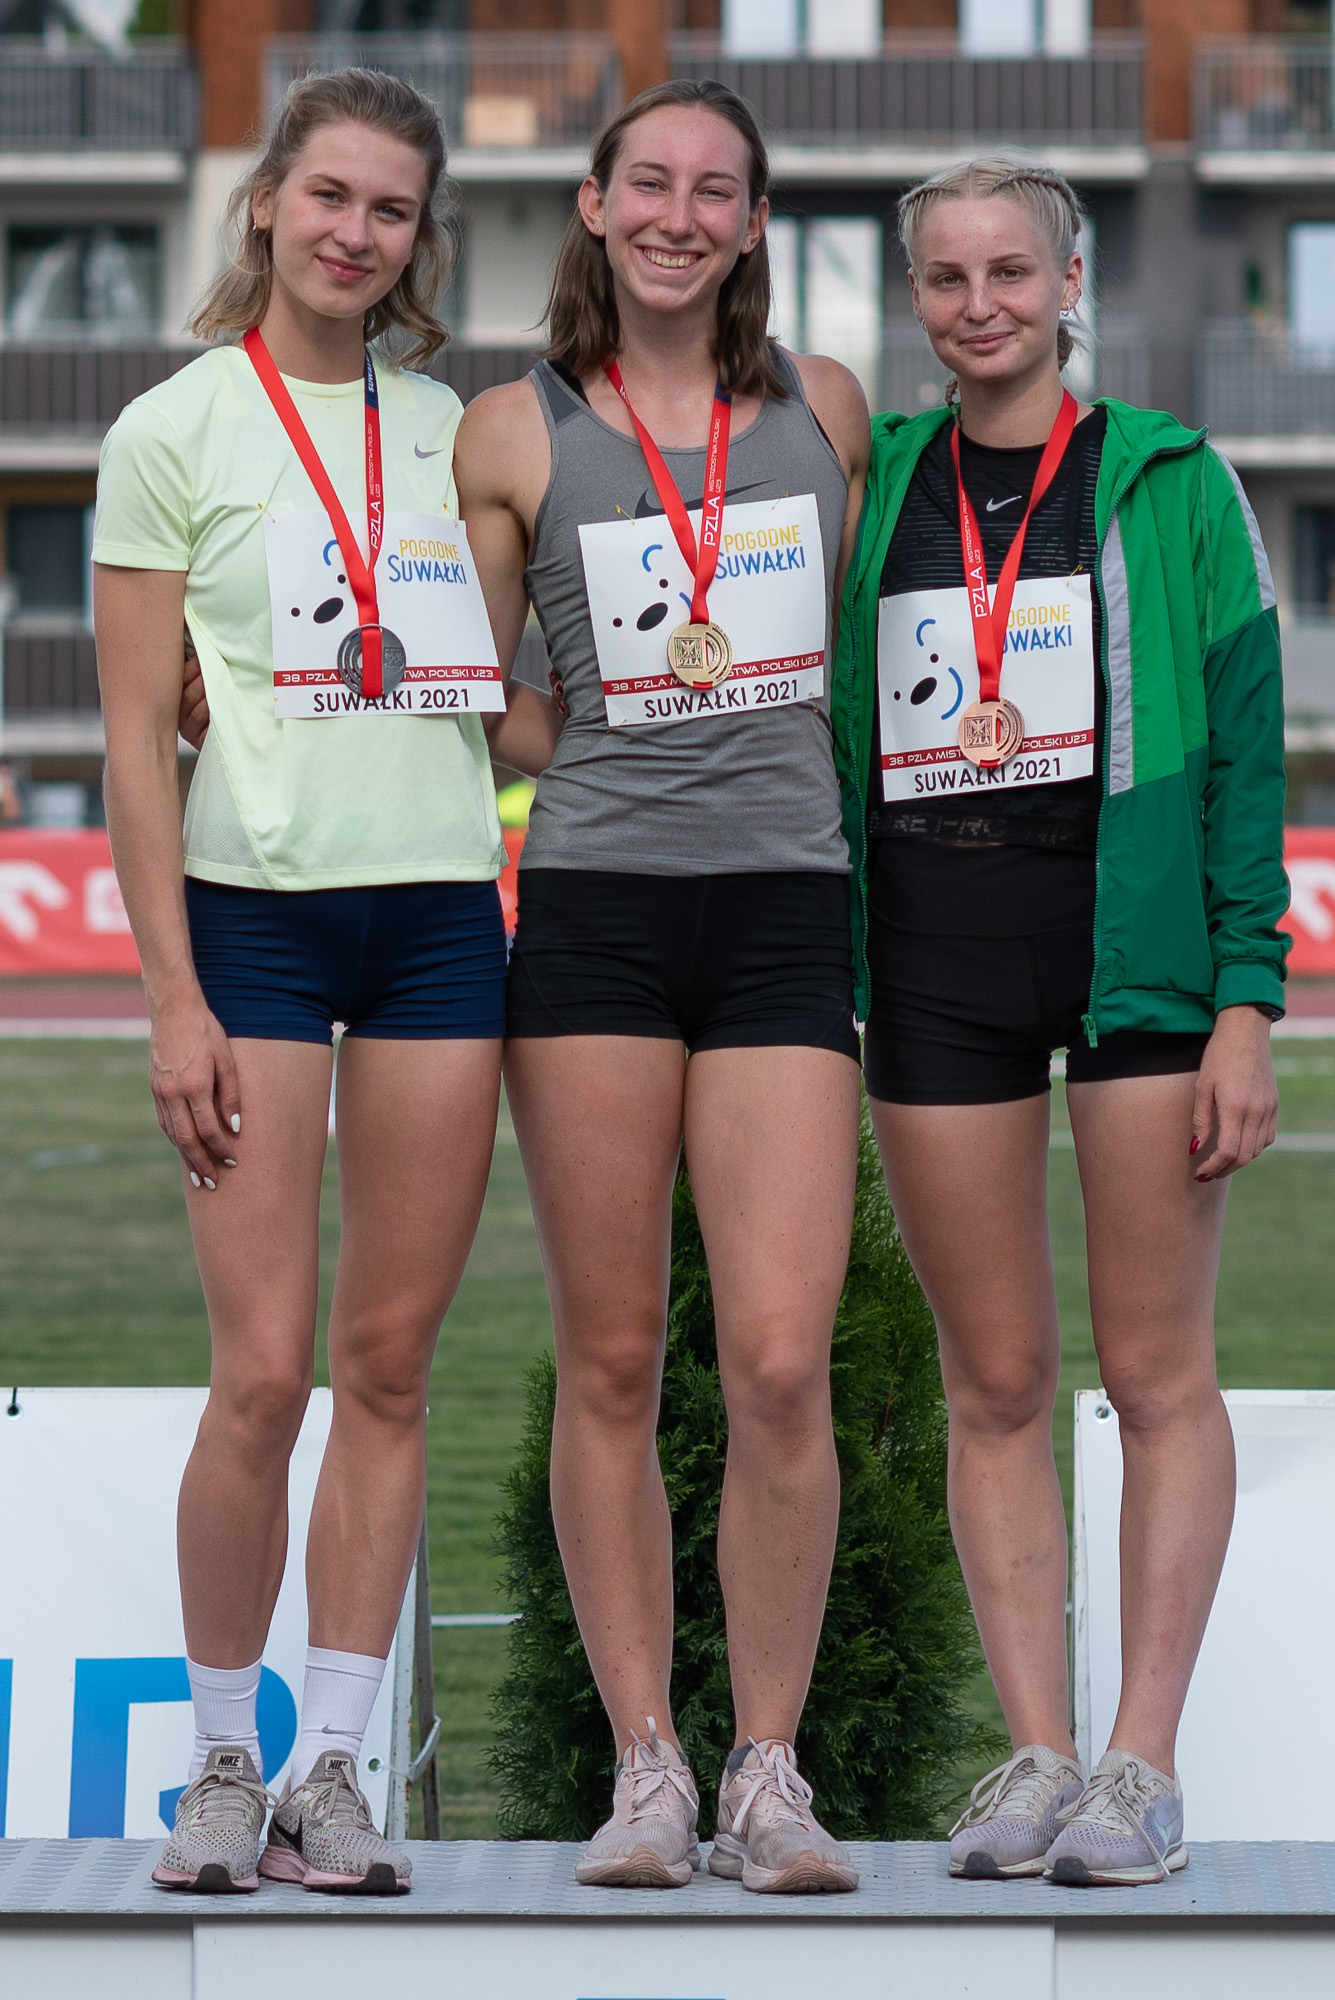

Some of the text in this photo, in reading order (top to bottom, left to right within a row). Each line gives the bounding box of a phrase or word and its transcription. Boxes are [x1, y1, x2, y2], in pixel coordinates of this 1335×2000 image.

[370, 501, 382, 549] PZLA
[704, 496, 721, 546] PZLA
[399, 539, 461, 562] POGODNE
[723, 524, 802, 553] POGODNE
[387, 554, 468, 585] SUWAŁKI
[715, 546, 806, 580] SUWAŁKI
[970, 566, 987, 618] PZLA
[1007, 603, 1072, 629] OGODNE
[281, 673, 303, 683] 38.
[305, 672, 338, 682] PZLA
[428, 668, 469, 678] POLSKI
[472, 668, 494, 678] U23
[611, 656, 819, 692] 38. PZLA POLSKI U23
[313, 688, 470, 713] SUWAŁKI 2021
[643, 679, 799, 718] SUWAŁKI 2021
[888, 756, 907, 767] 38.
[908, 751, 935, 764] PZLA
[1022, 737, 1063, 750] POLSKI
[1064, 733, 1088, 745] U23
[1013, 757, 1062, 782] 2021
[218, 1754, 241, 1767] NIKE
[327, 1759, 349, 1770] NIKE
